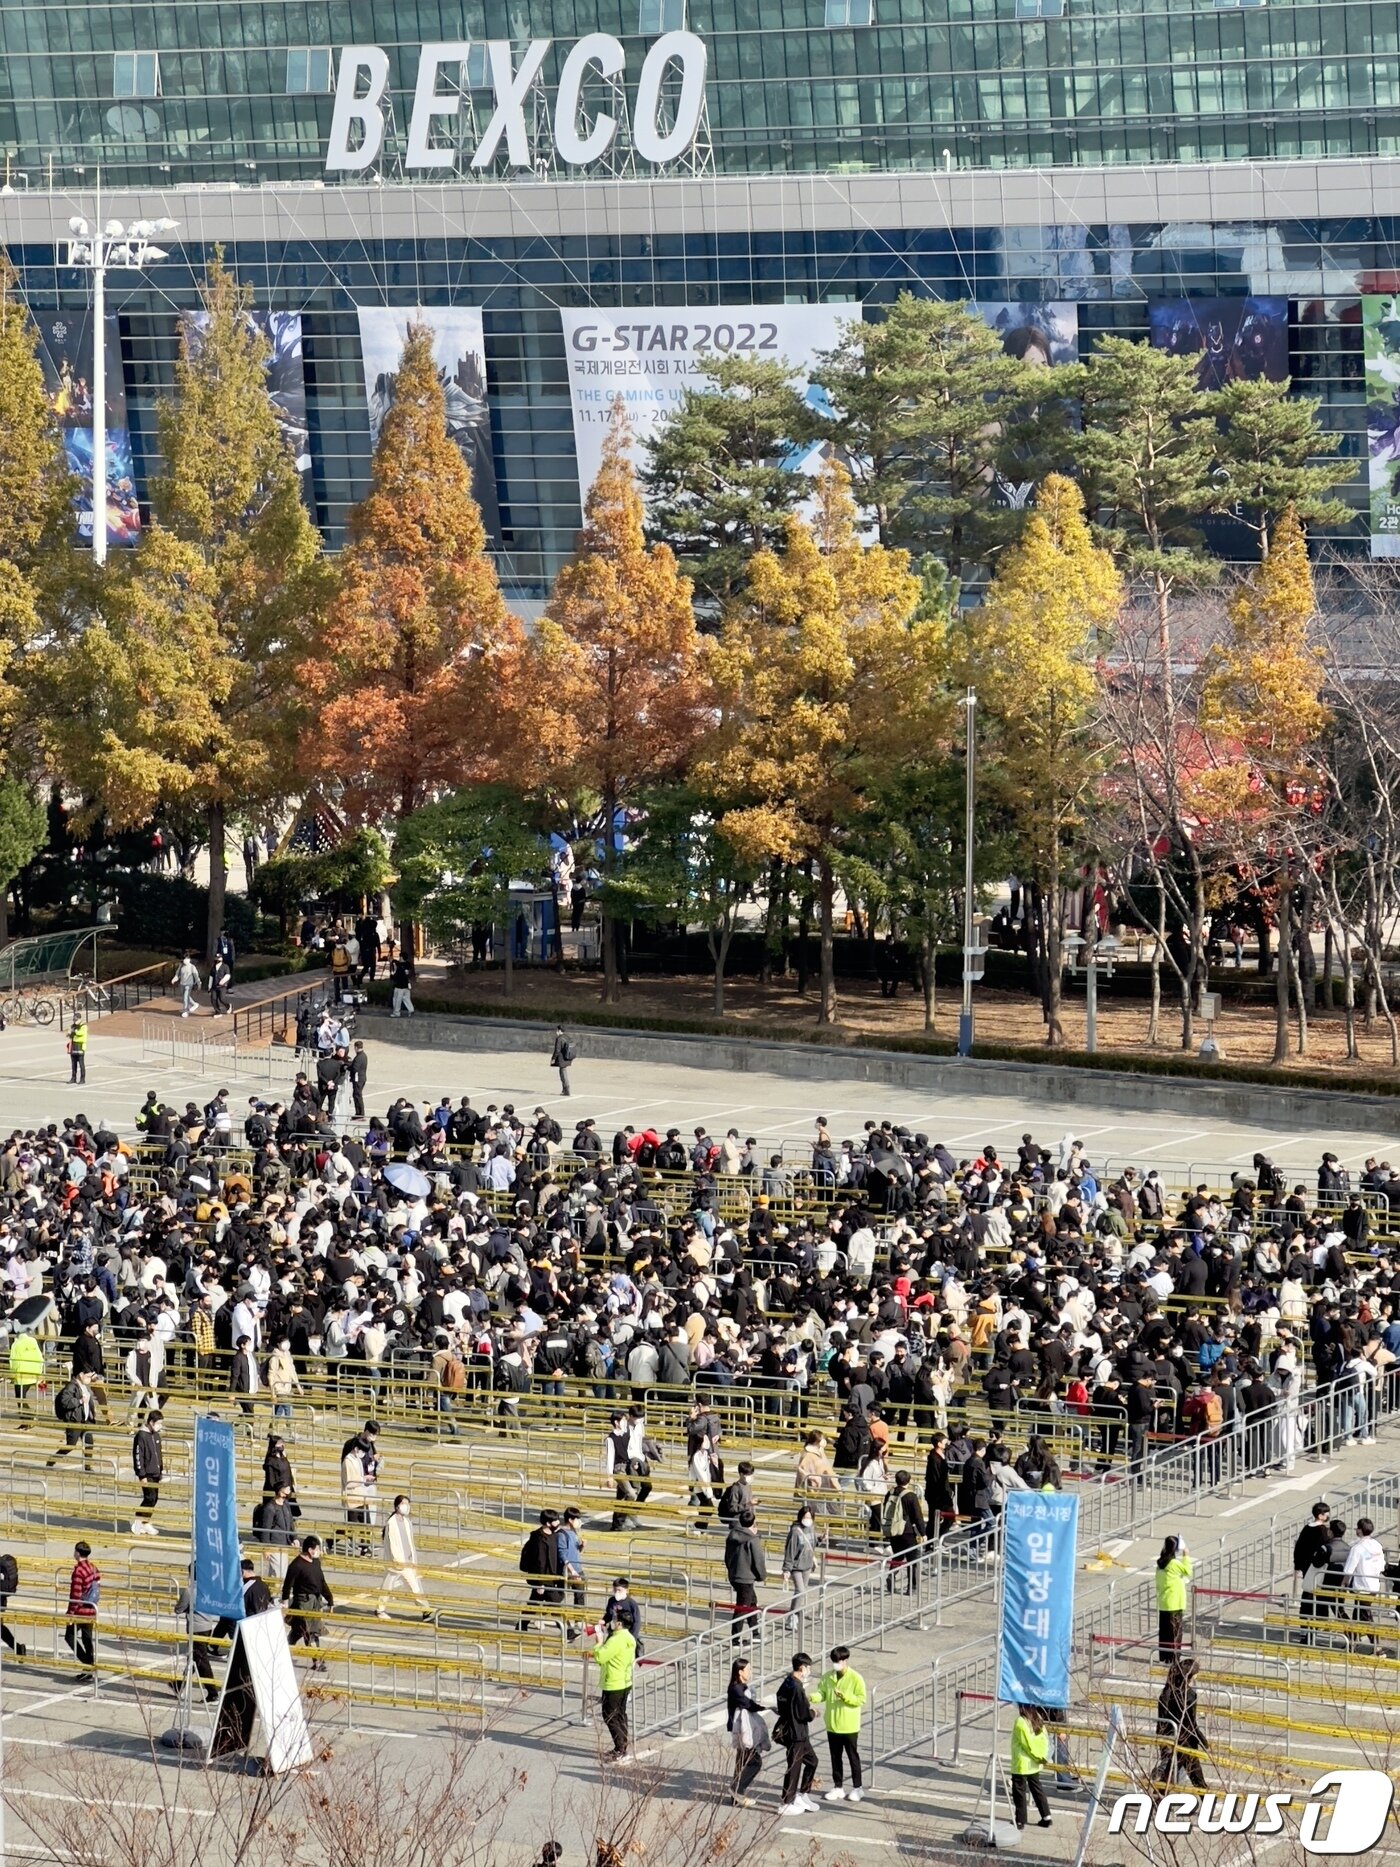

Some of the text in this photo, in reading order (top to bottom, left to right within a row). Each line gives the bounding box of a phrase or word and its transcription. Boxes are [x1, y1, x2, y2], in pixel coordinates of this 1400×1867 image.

[326, 30, 707, 171] BEXCO
[574, 360, 702, 375] 국제게임전시회 지스
[577, 389, 601, 401] THE
[605, 388, 664, 402] GMING
[205, 1456, 225, 1590] 입장대기
[1012, 1503, 1072, 1522] 제2전시장
[1023, 1532, 1053, 1676] 입장대기
